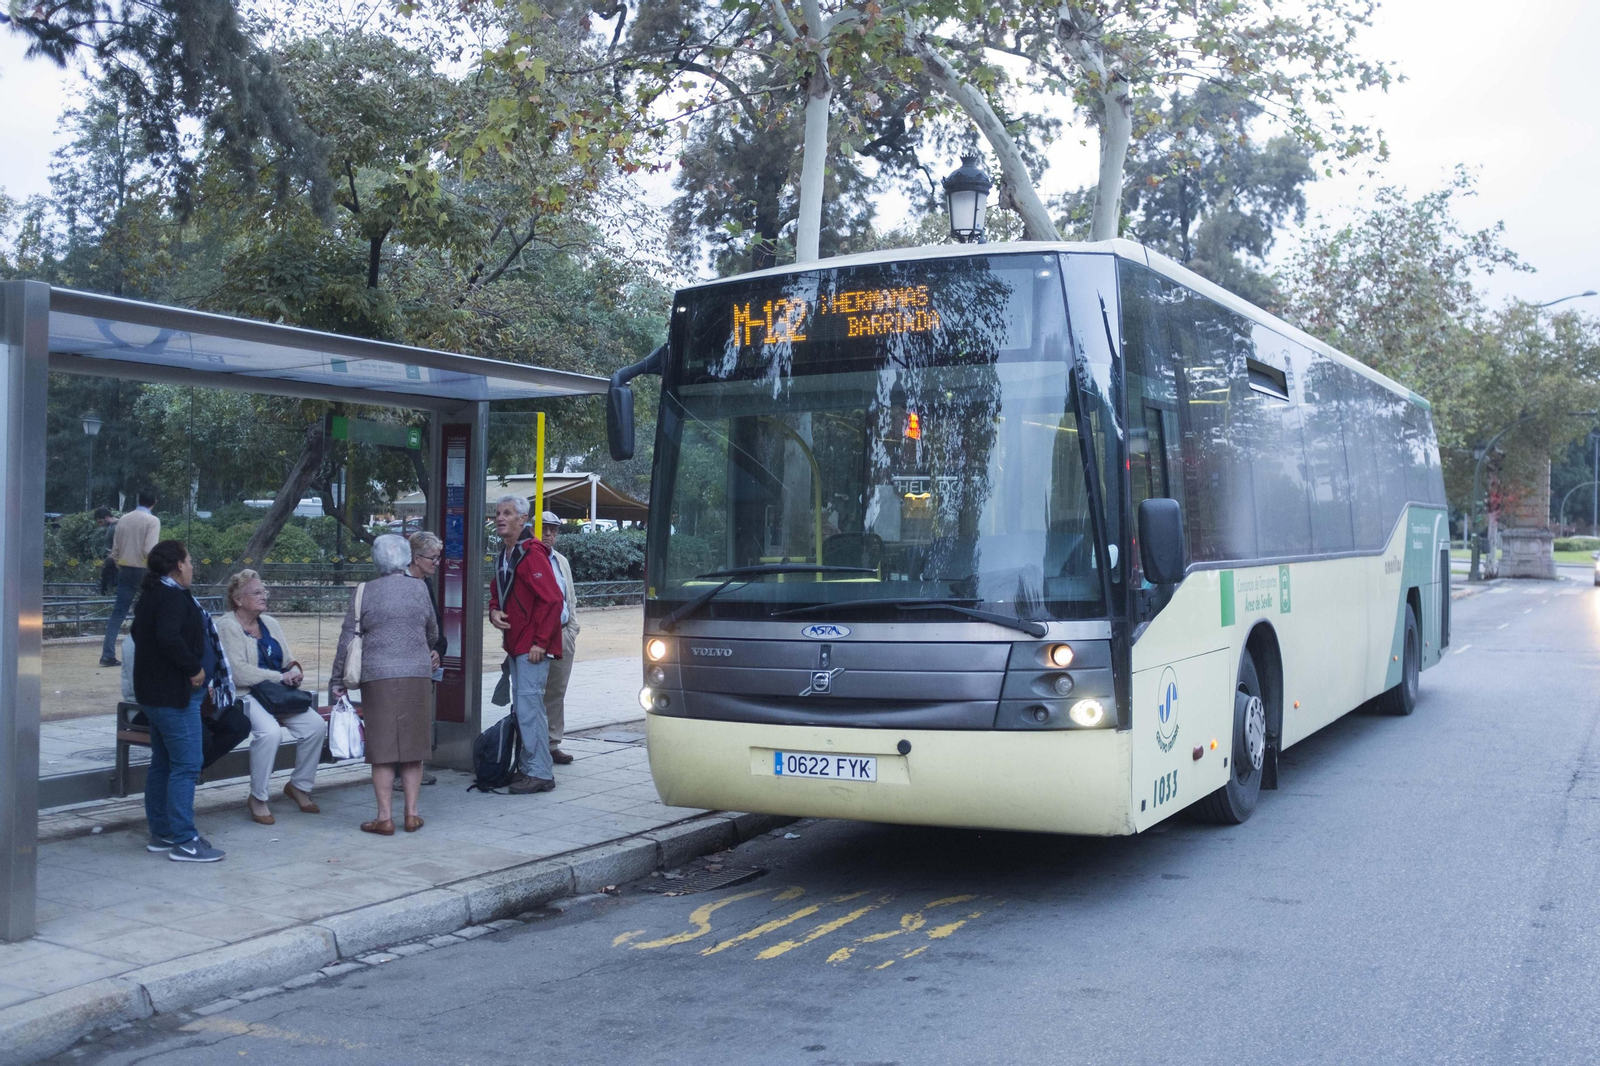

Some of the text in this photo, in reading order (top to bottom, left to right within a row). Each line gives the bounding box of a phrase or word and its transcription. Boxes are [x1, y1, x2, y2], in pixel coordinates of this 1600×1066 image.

[831, 285, 929, 314] HERMANAS
[847, 309, 941, 337] BARRIADA
[691, 647, 733, 657] VOLVO
[787, 755, 829, 776] 0622
[836, 758, 870, 778] FYK
[1153, 769, 1178, 809] 1033
